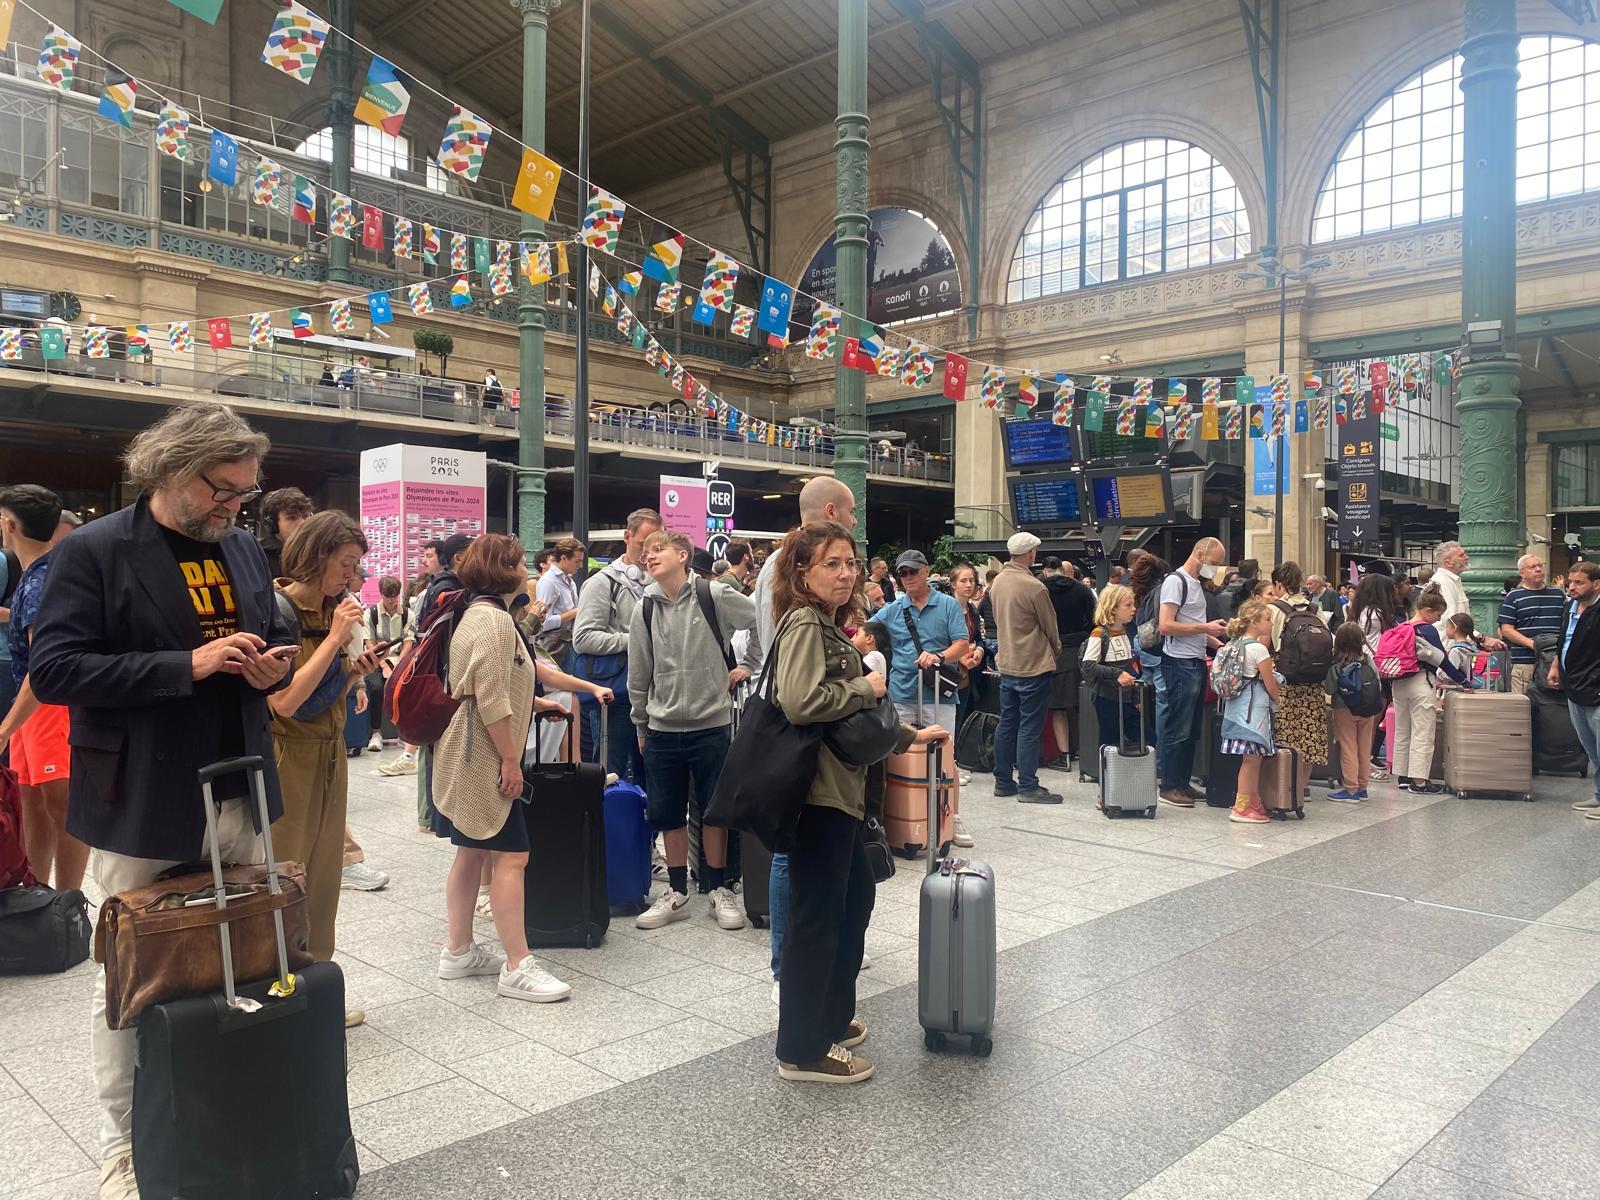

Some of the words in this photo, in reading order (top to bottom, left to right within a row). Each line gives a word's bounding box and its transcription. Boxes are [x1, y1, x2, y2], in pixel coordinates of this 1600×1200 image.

[406, 486, 435, 495] Rejoindre
[406, 493, 441, 502] Olympiques
[711, 491, 731, 506] RER
[713, 541, 728, 560] M
